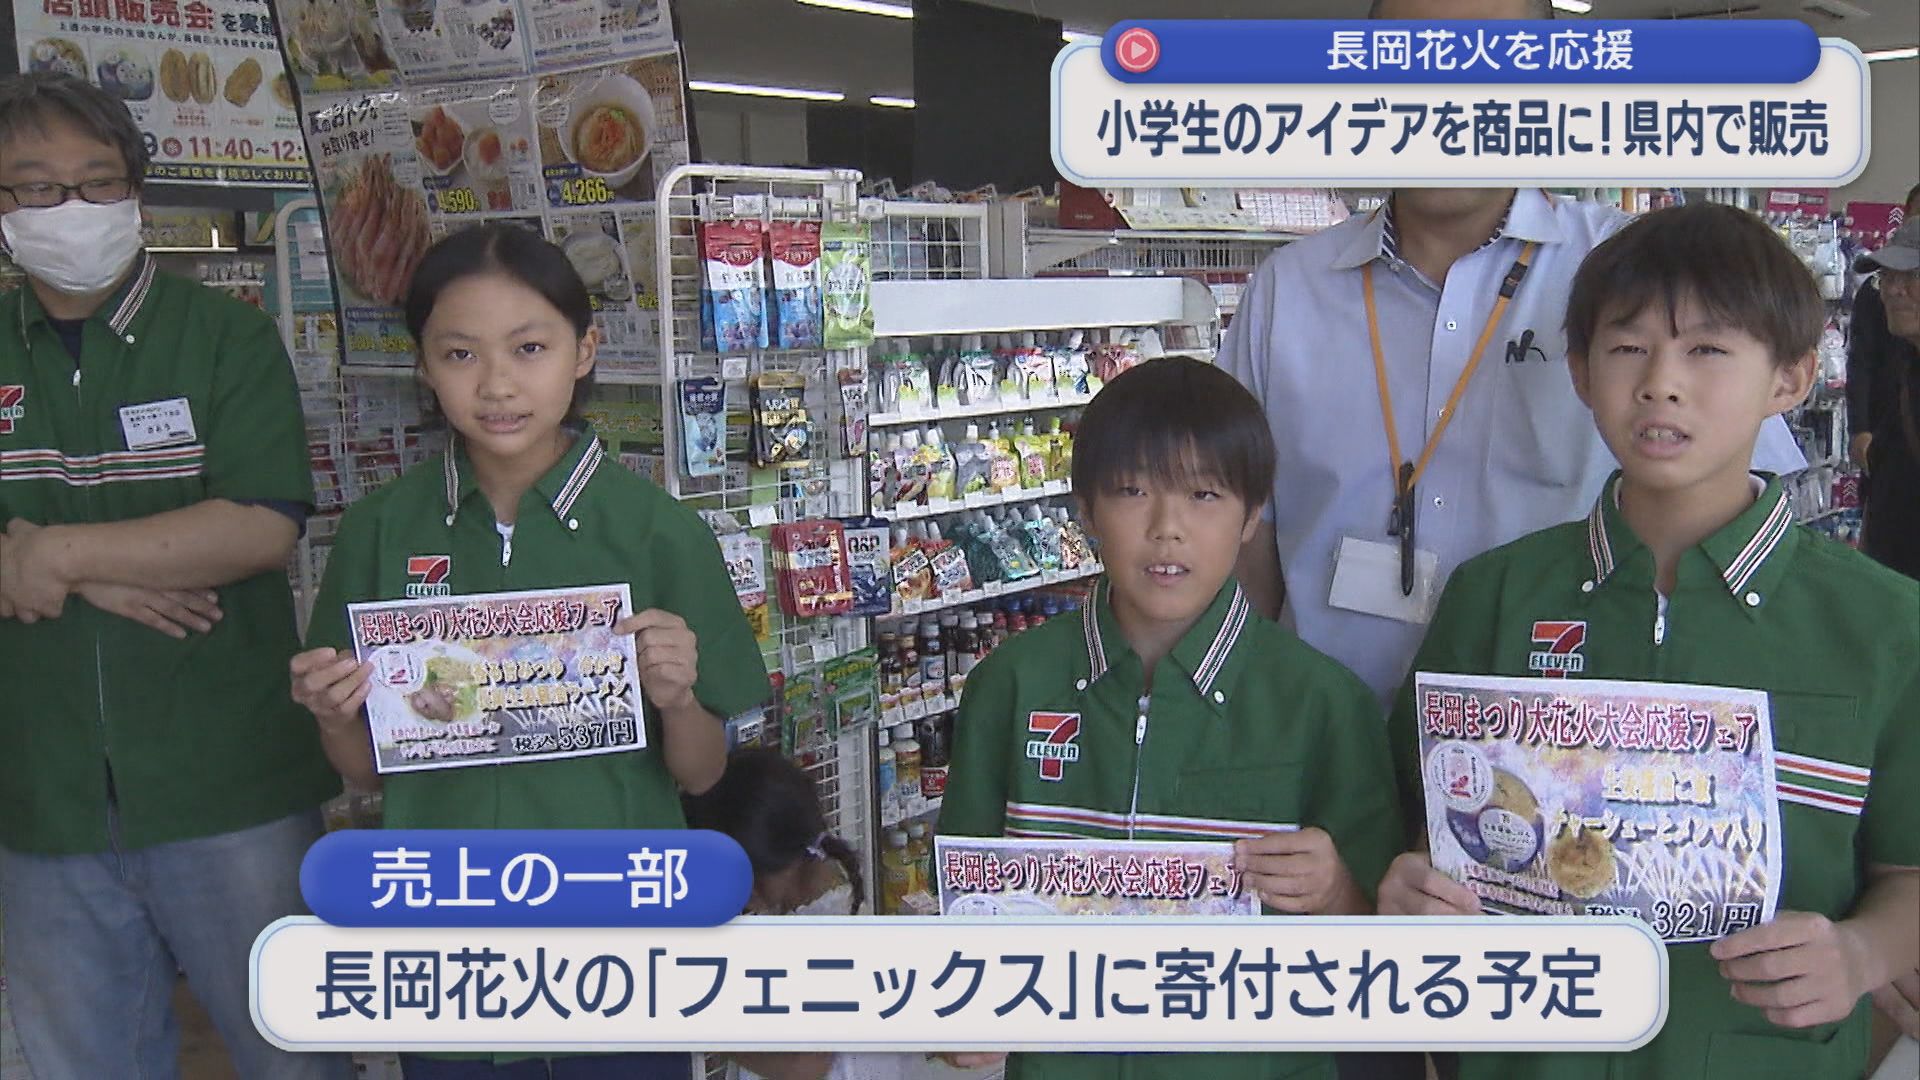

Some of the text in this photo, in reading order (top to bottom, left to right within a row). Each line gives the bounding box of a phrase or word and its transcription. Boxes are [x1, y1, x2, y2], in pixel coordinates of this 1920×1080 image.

[359, 596, 621, 645] 長岡まつり大花火大会応援フェア
[1421, 691, 1760, 754] 長岡まつり大花火大会応援フェア
[943, 850, 1243, 900] 長岡まつり大花火大会応援フェア
